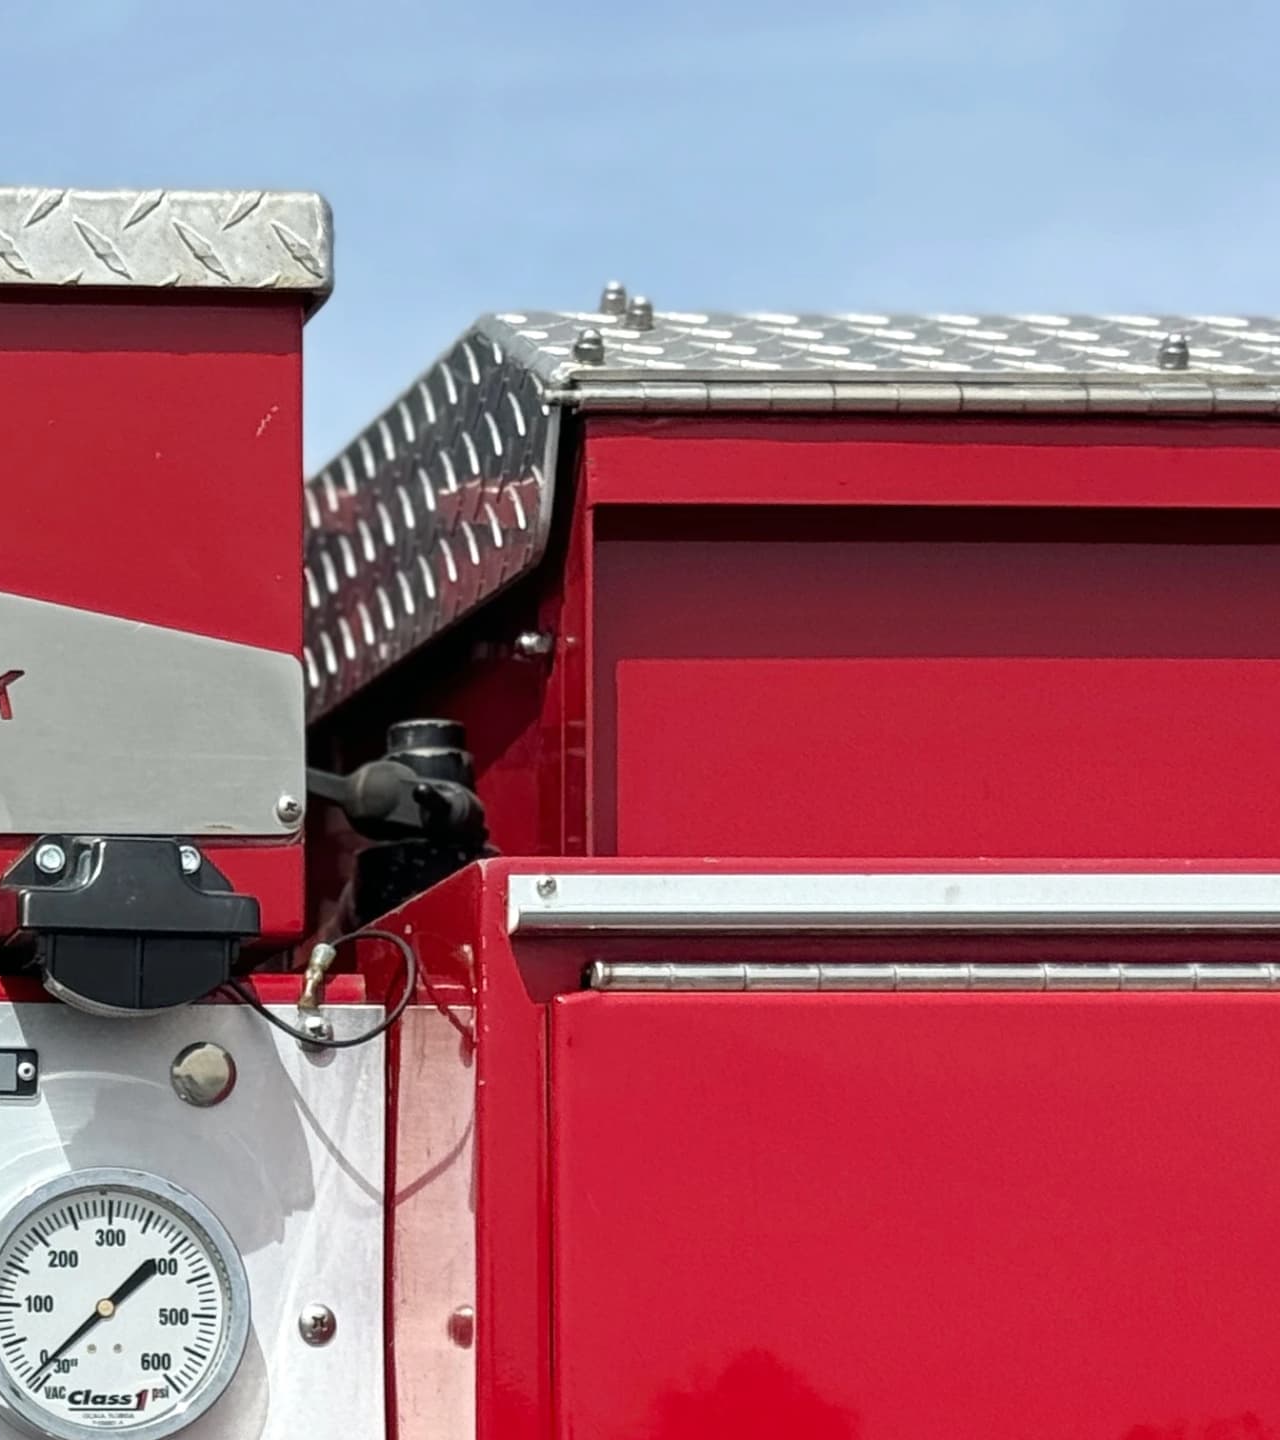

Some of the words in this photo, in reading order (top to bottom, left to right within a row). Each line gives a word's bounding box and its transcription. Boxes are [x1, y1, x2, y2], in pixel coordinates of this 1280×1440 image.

[95, 1229, 126, 1246] 300
[48, 1250, 78, 1268] 200
[24, 1295, 54, 1312] 100
[158, 1308, 190, 1326] 500
[141, 1353, 171, 1370] 600
[44, 1386, 66, 1400] VAC
[152, 1386, 169, 1402] psi
